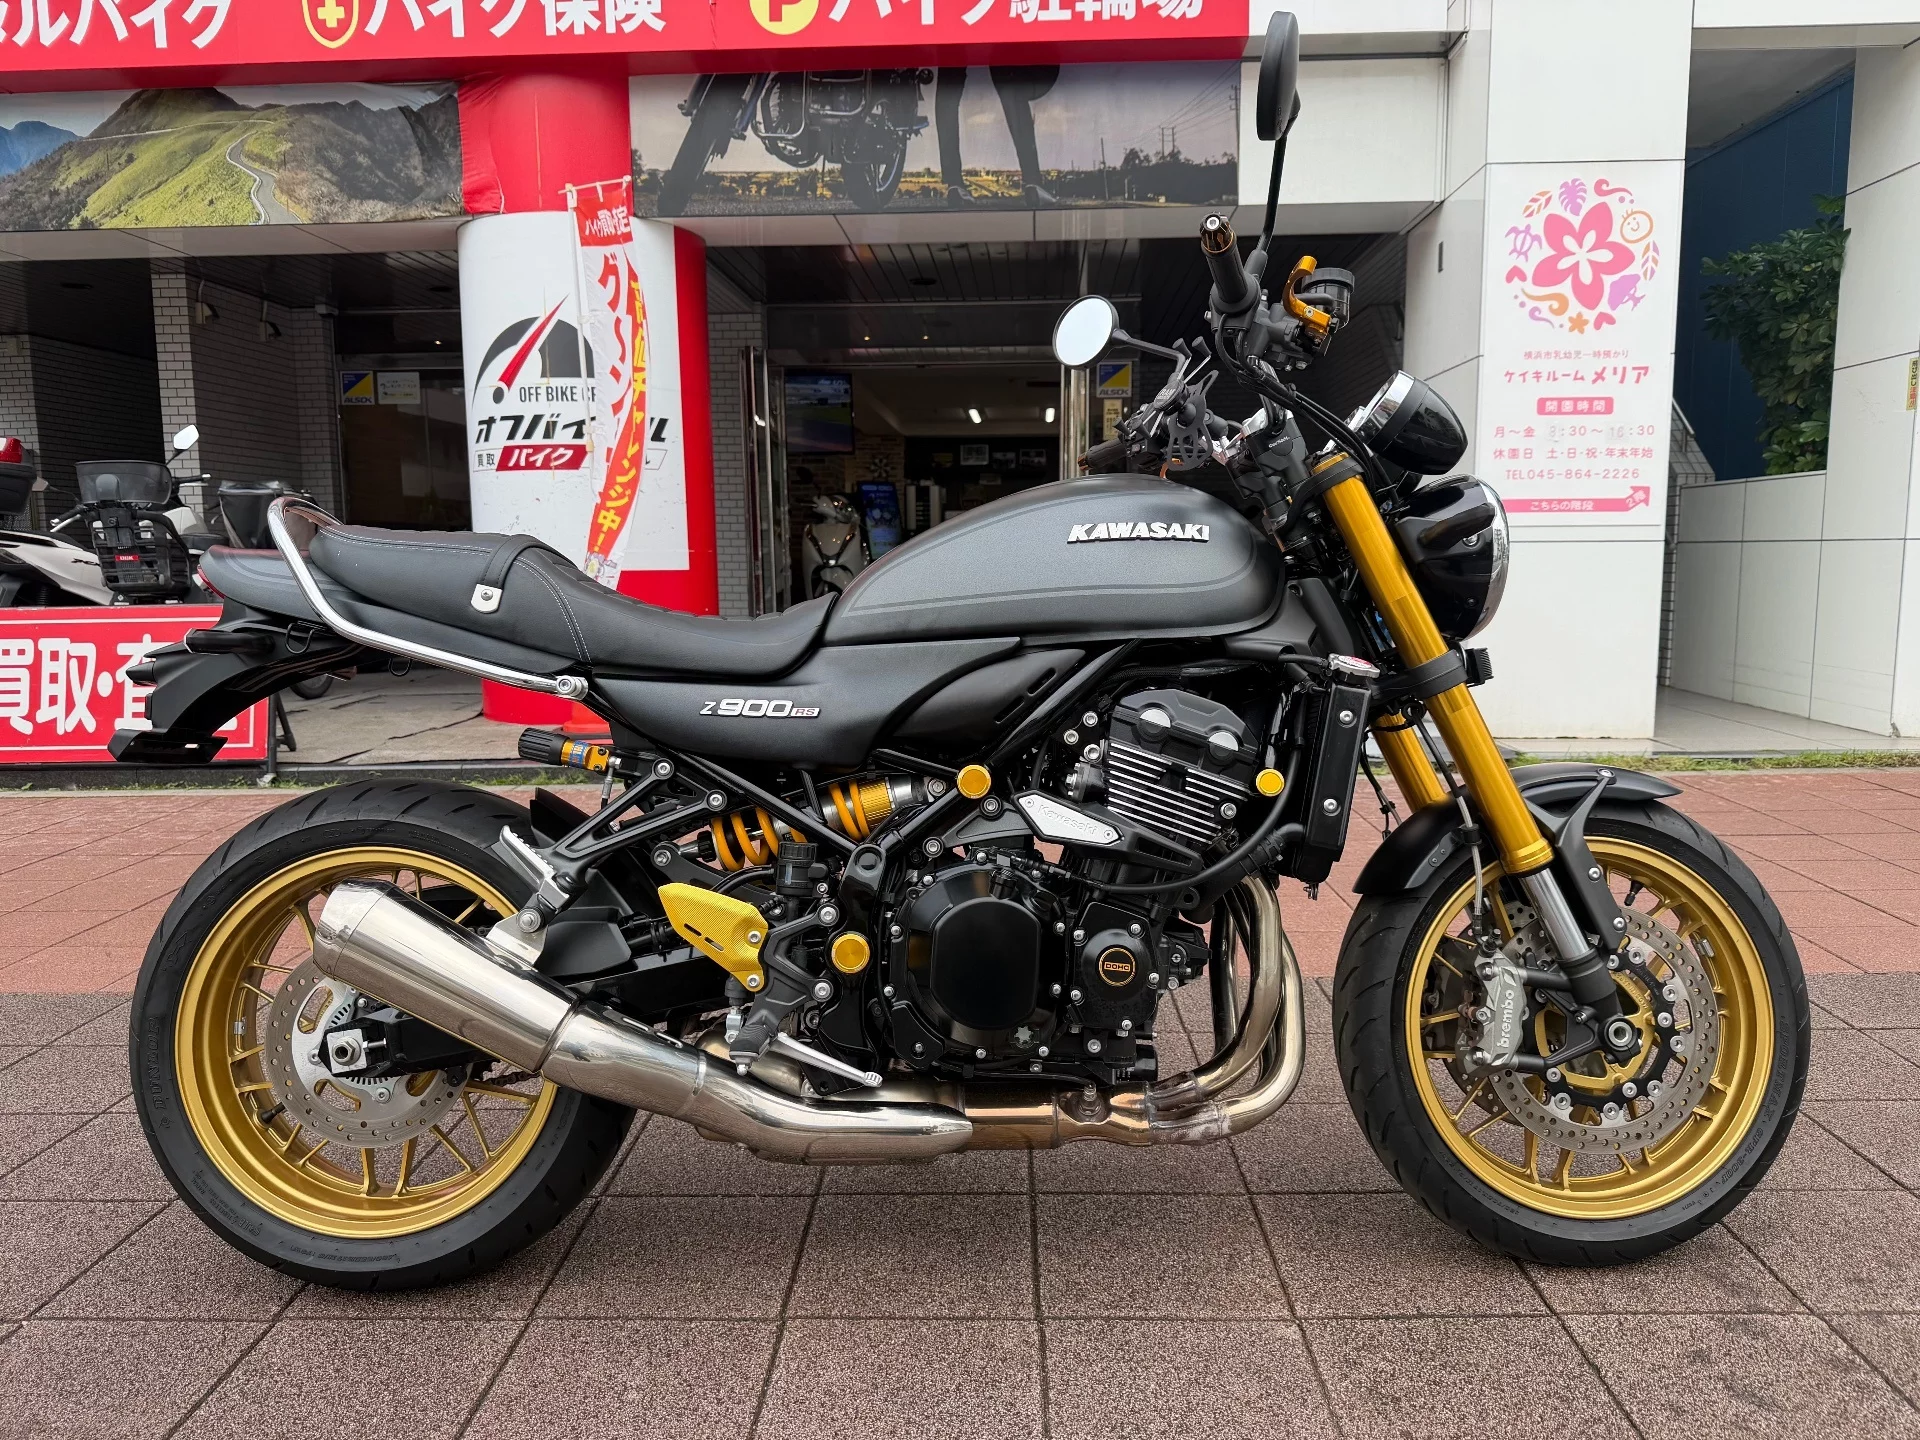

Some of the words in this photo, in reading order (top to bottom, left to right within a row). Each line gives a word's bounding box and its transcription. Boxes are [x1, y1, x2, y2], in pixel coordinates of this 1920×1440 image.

[0, 0, 231, 49] ルバイク
[1504, 370, 1585, 383] ケイキルーム
[1592, 366, 1649, 384] メリア
[519, 386, 542, 403] OFF
[547, 386, 578, 402] BIKE
[1545, 400, 1606, 413] 開園時間
[477, 453, 496, 466] 買取
[508, 447, 574, 467] バイク
[1493, 447, 1534, 460] 休園日
[1505, 468, 1640, 480] TEL045-864-2226
[1530, 501, 1594, 511] こちらの階段
[1067, 522, 1210, 544] KAWASAKI
[1037, 804, 1098, 835] Kawasaki
[1104, 962, 1131, 972] DOHC
[1496, 989, 1515, 1048] brembo
